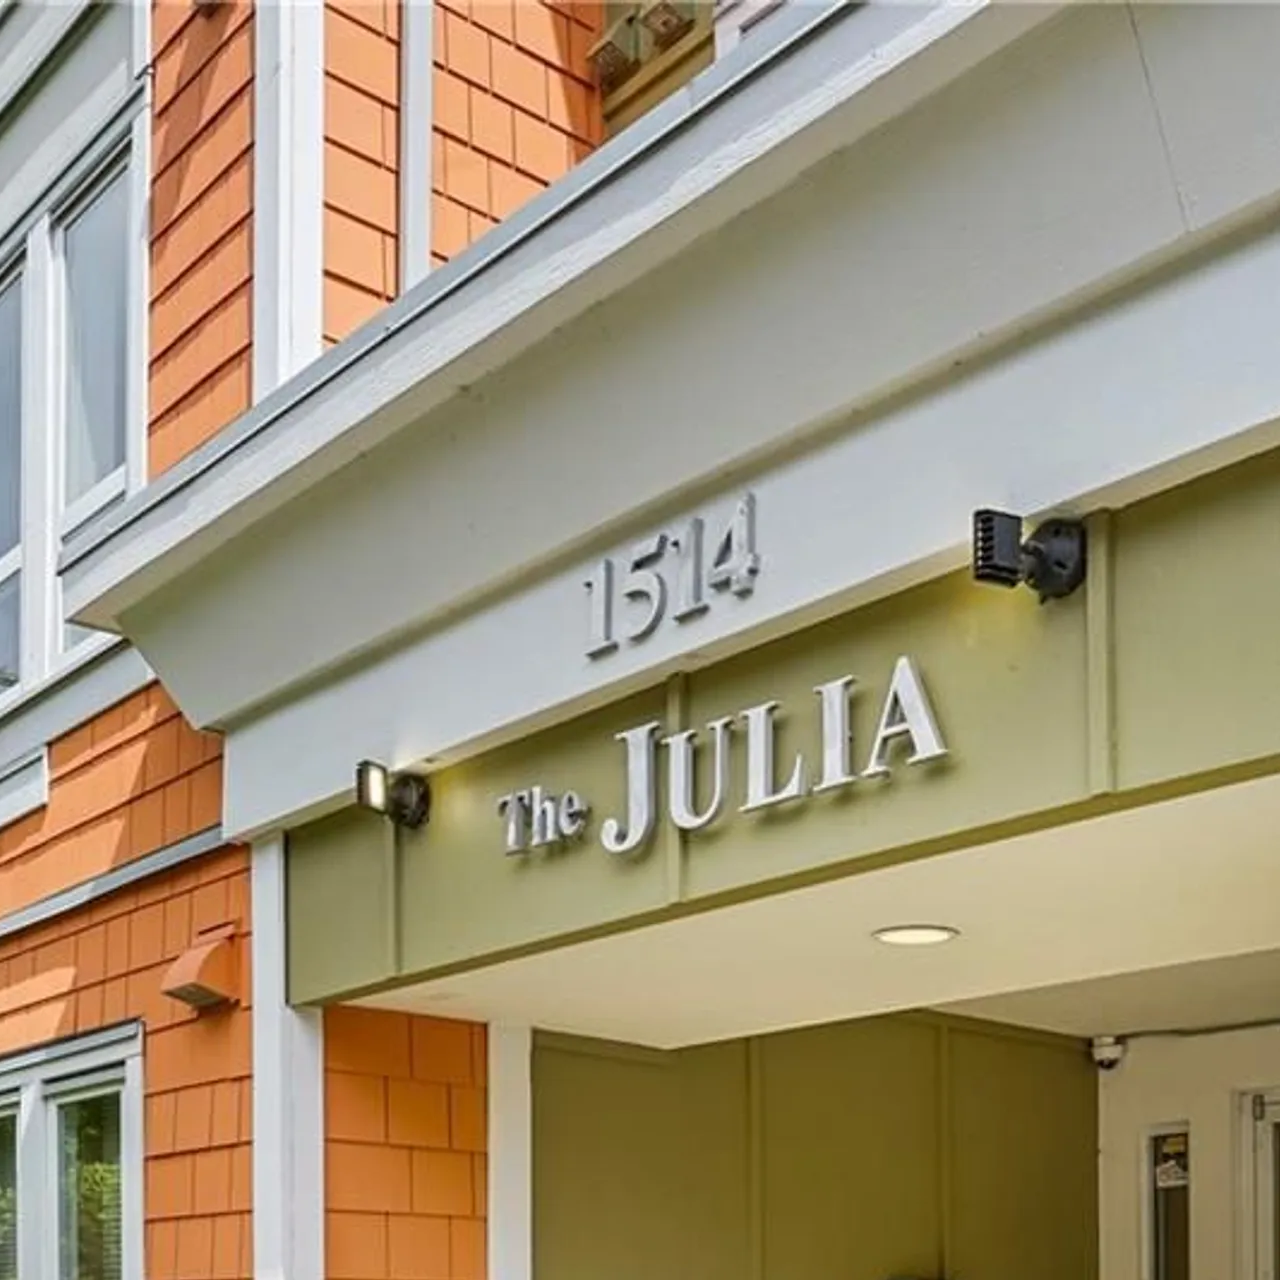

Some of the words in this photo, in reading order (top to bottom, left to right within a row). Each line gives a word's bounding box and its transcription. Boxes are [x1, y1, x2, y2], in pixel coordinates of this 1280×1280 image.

[584, 491, 761, 660] 1514
[498, 785, 589, 856] The
[601, 655, 948, 855] JULIA
